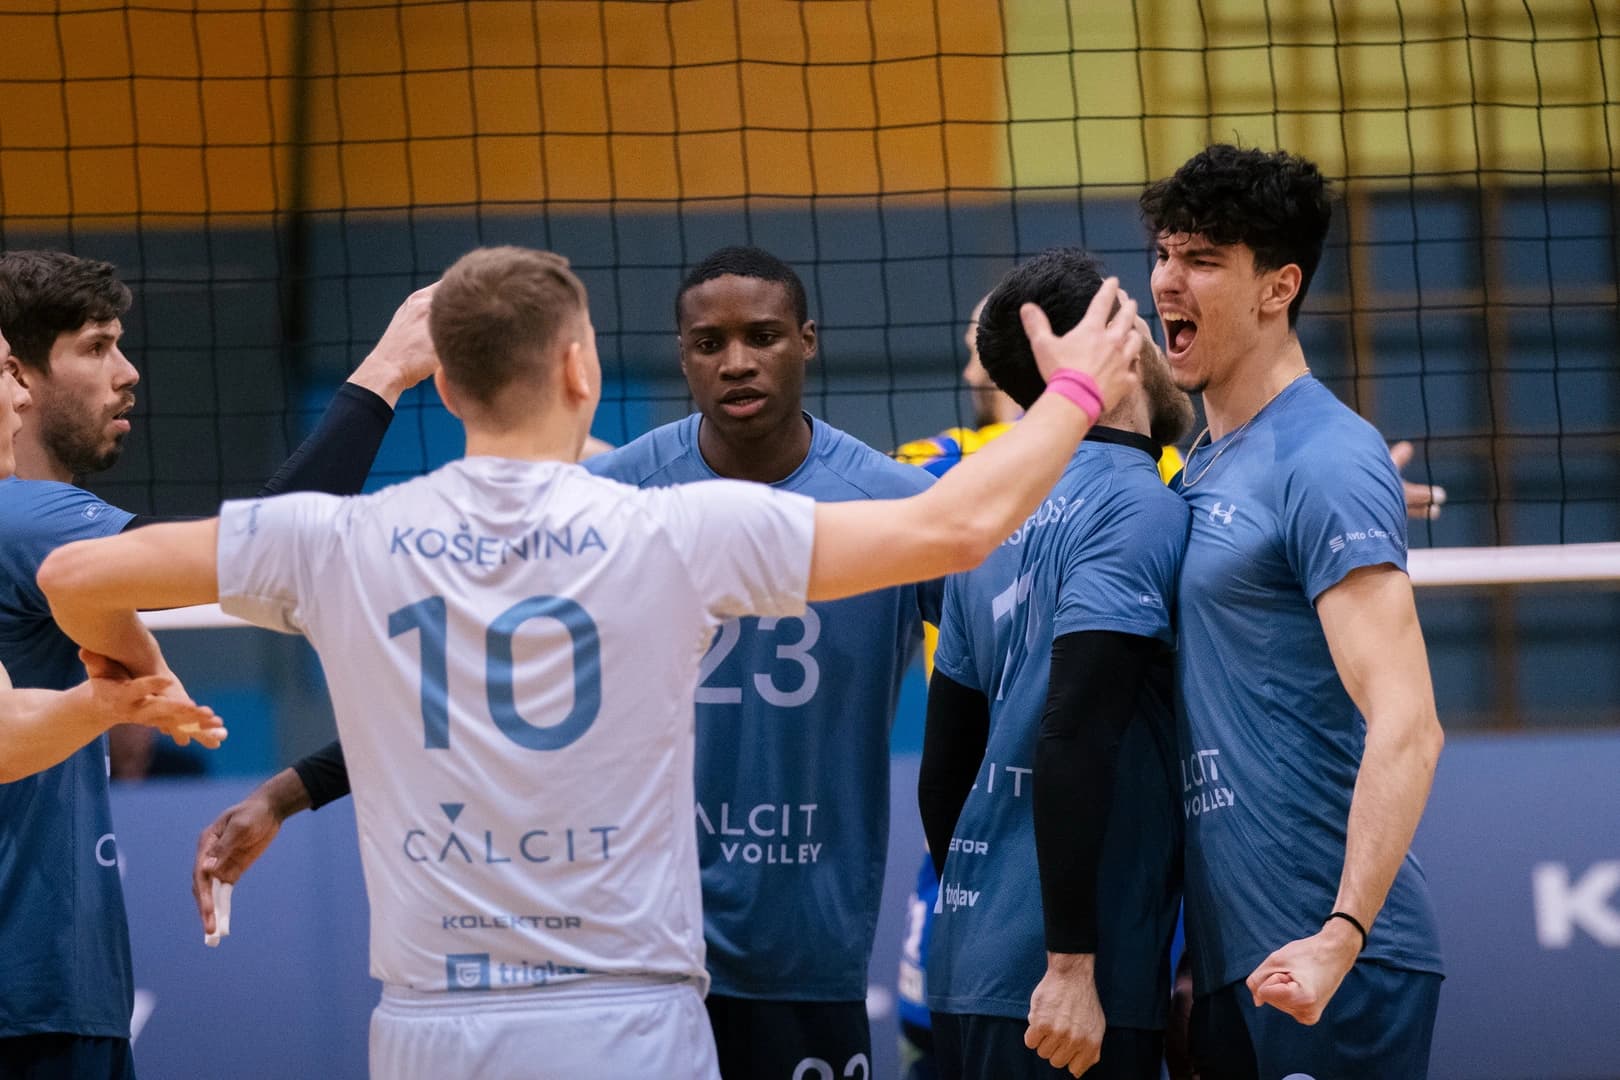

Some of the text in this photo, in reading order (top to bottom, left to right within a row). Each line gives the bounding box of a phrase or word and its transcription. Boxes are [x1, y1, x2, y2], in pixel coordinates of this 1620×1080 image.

[389, 523, 608, 566] KOŠENINA
[388, 595, 602, 751] 10
[694, 605, 821, 708] 23
[1181, 748, 1219, 792] LCIT
[695, 802, 818, 837] ALCIT
[1184, 787, 1235, 819] VOLLEY
[403, 825, 620, 864] CALCIT
[720, 842, 823, 864] VOLLEY
[442, 914, 582, 929] KOLEKTOR
[1531, 860, 1620, 951] K
